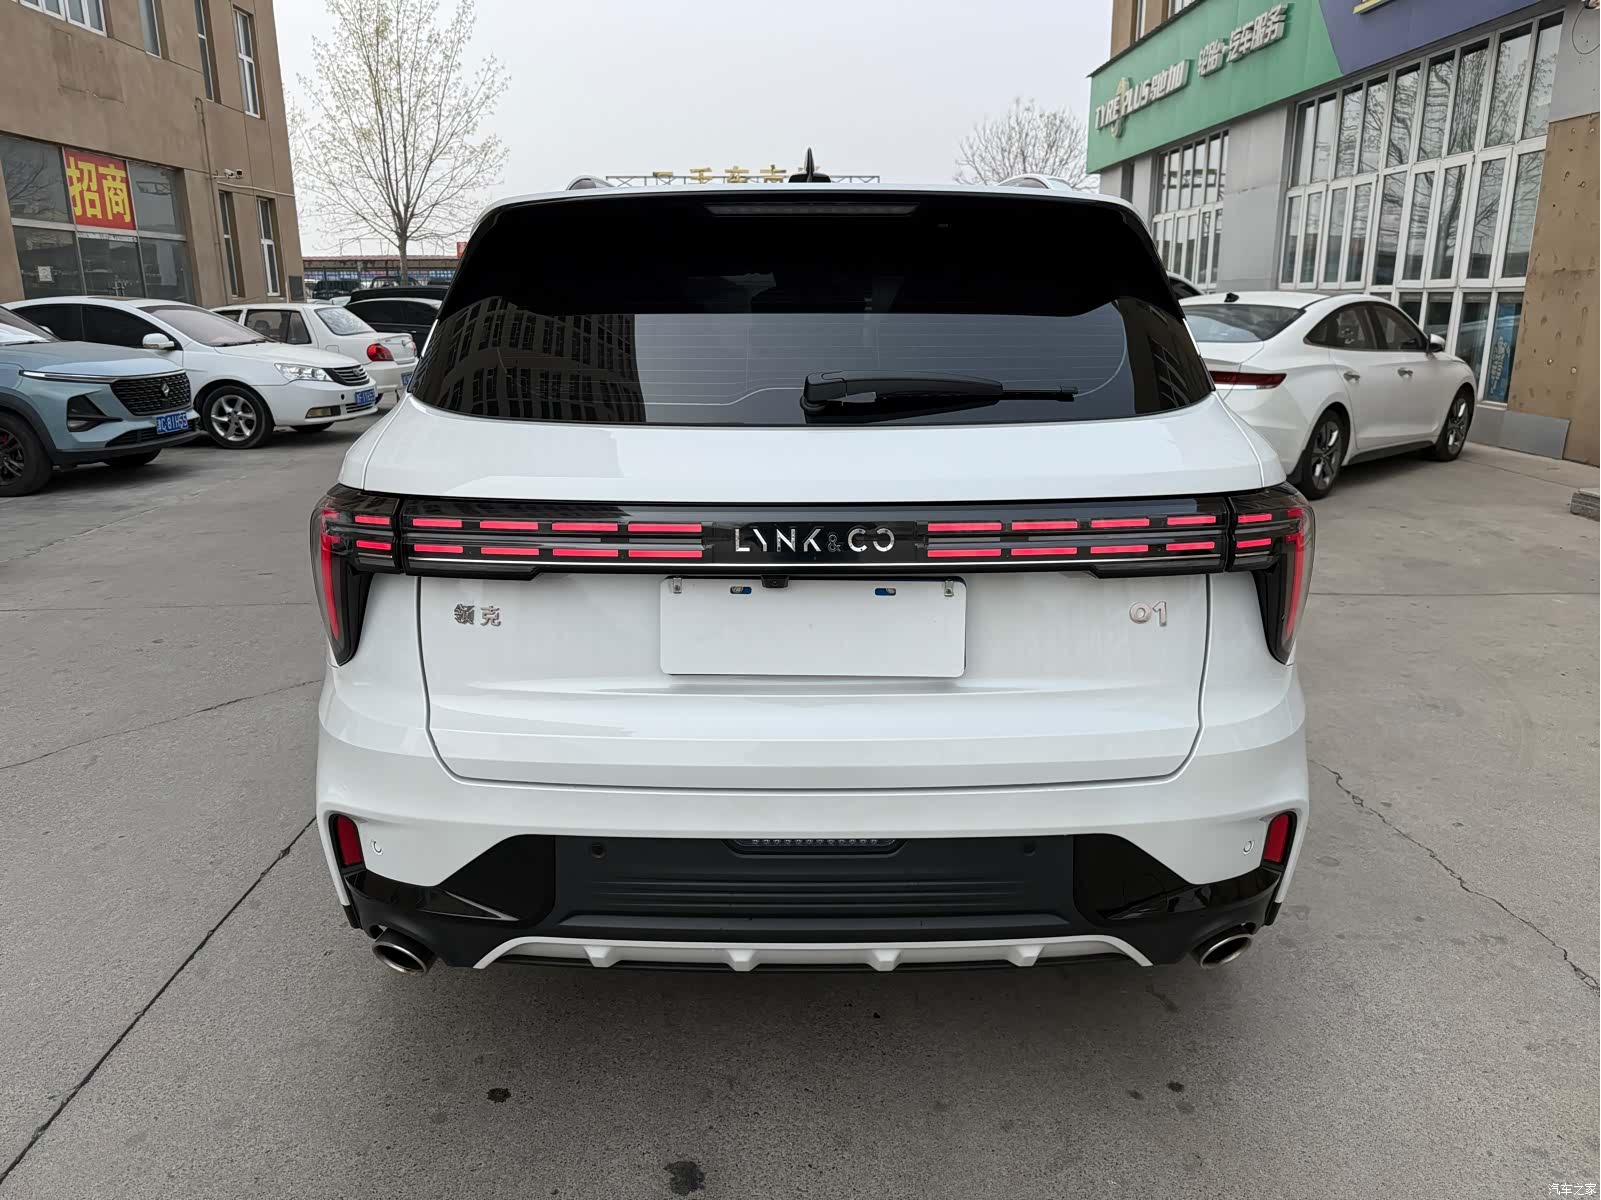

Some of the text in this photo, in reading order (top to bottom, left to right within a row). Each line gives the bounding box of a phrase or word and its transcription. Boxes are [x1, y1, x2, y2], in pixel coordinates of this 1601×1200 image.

[67, 156, 131, 223] 招商
[453, 603, 502, 627] 领克
[1129, 600, 1168, 627] 01
